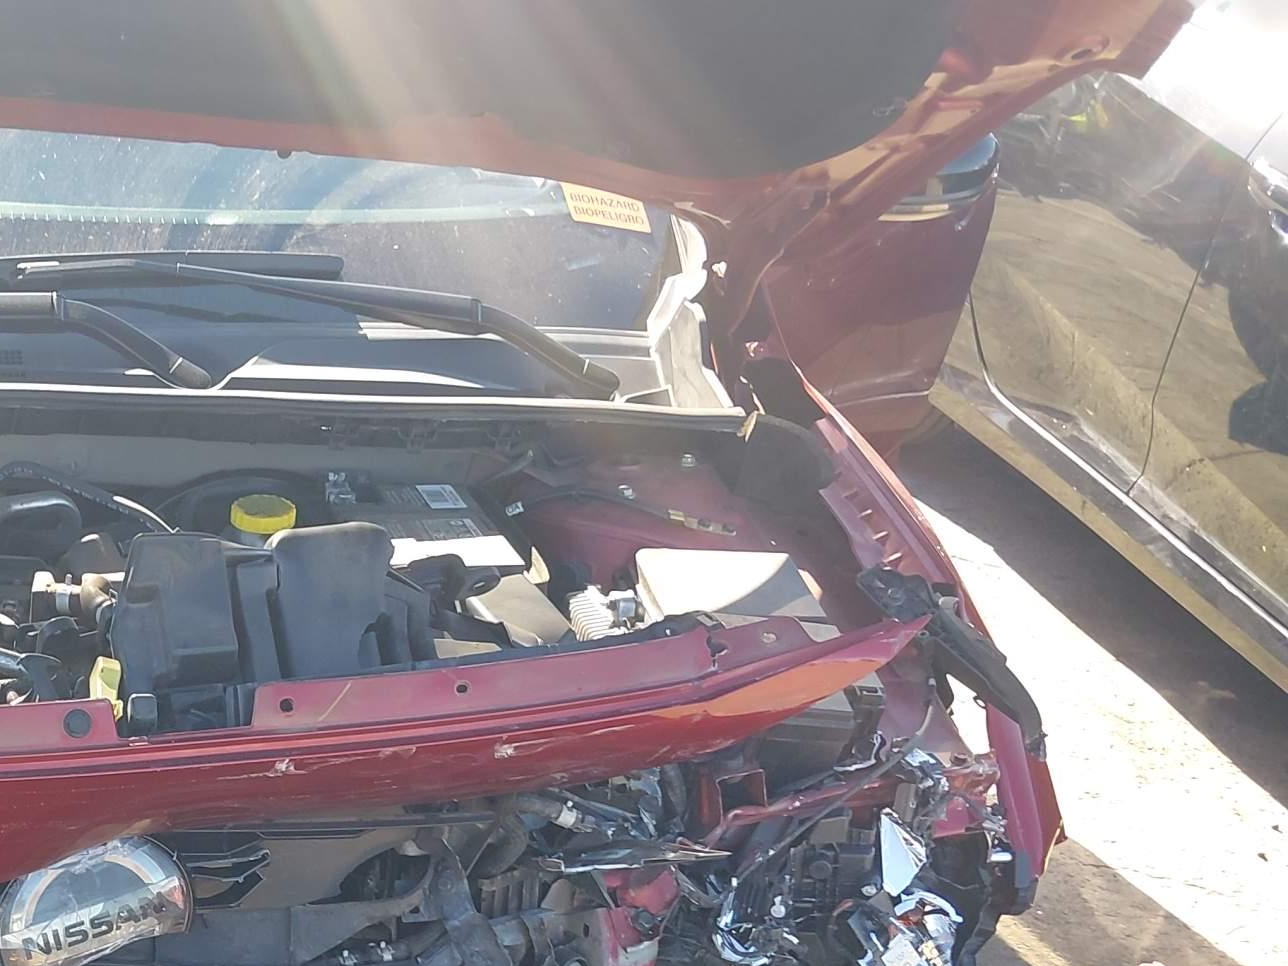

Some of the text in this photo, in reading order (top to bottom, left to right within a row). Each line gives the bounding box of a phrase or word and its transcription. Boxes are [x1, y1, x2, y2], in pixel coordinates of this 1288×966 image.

[569, 192, 640, 212] BIOHAZARD
[573, 205, 645, 225] BIOPELIGRO
[21, 890, 172, 960] NISSAN
